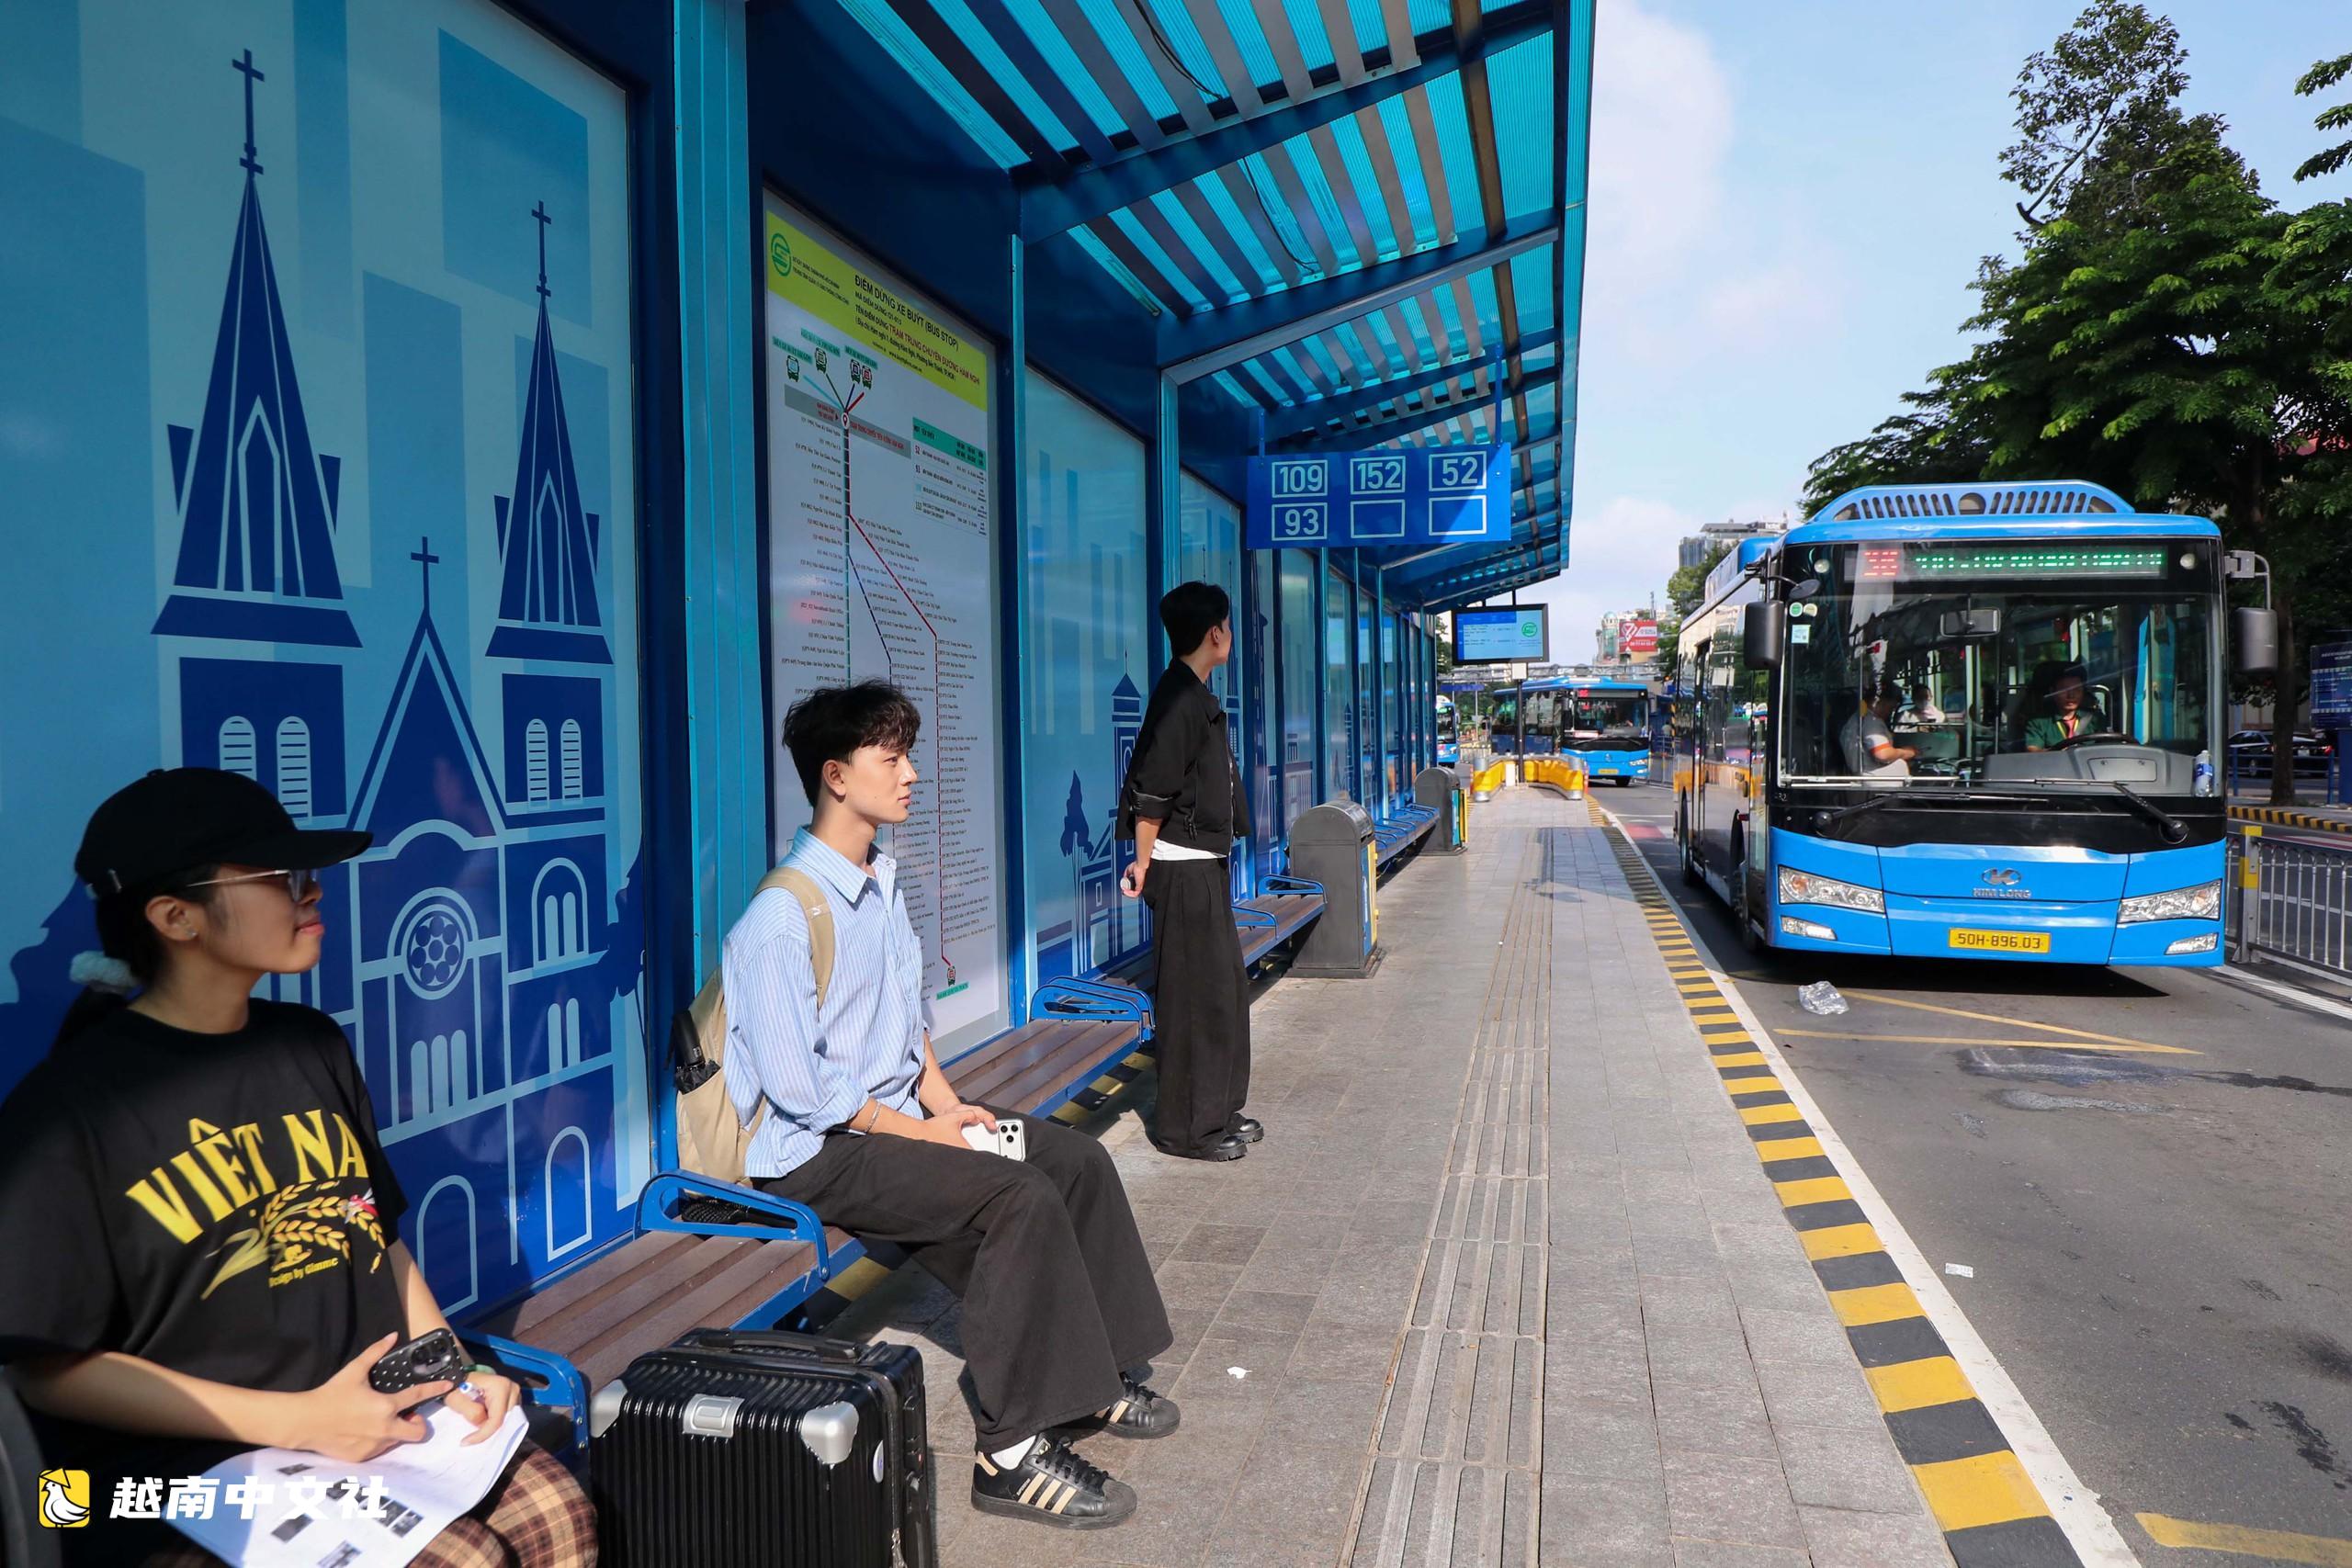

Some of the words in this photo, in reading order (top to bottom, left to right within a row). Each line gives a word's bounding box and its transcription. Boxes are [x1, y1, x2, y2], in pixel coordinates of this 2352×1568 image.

[896, 302, 906, 317] XE
[907, 307, 924, 329] BUÝT
[925, 320, 940, 339] (BUS
[940, 330, 959, 353] STOP)
[1280, 464, 1323, 493] 109
[1357, 461, 1402, 491] 152
[1442, 457, 1478, 486] 52
[1284, 508, 1319, 536] 93
[1973, 887, 1996, 897] KIM
[1998, 888, 2032, 899] LONG
[1957, 932, 2041, 950] 50H-896.03
[124, 1116, 278, 1245] VIỆT
[280, 1109, 370, 1184] NA
